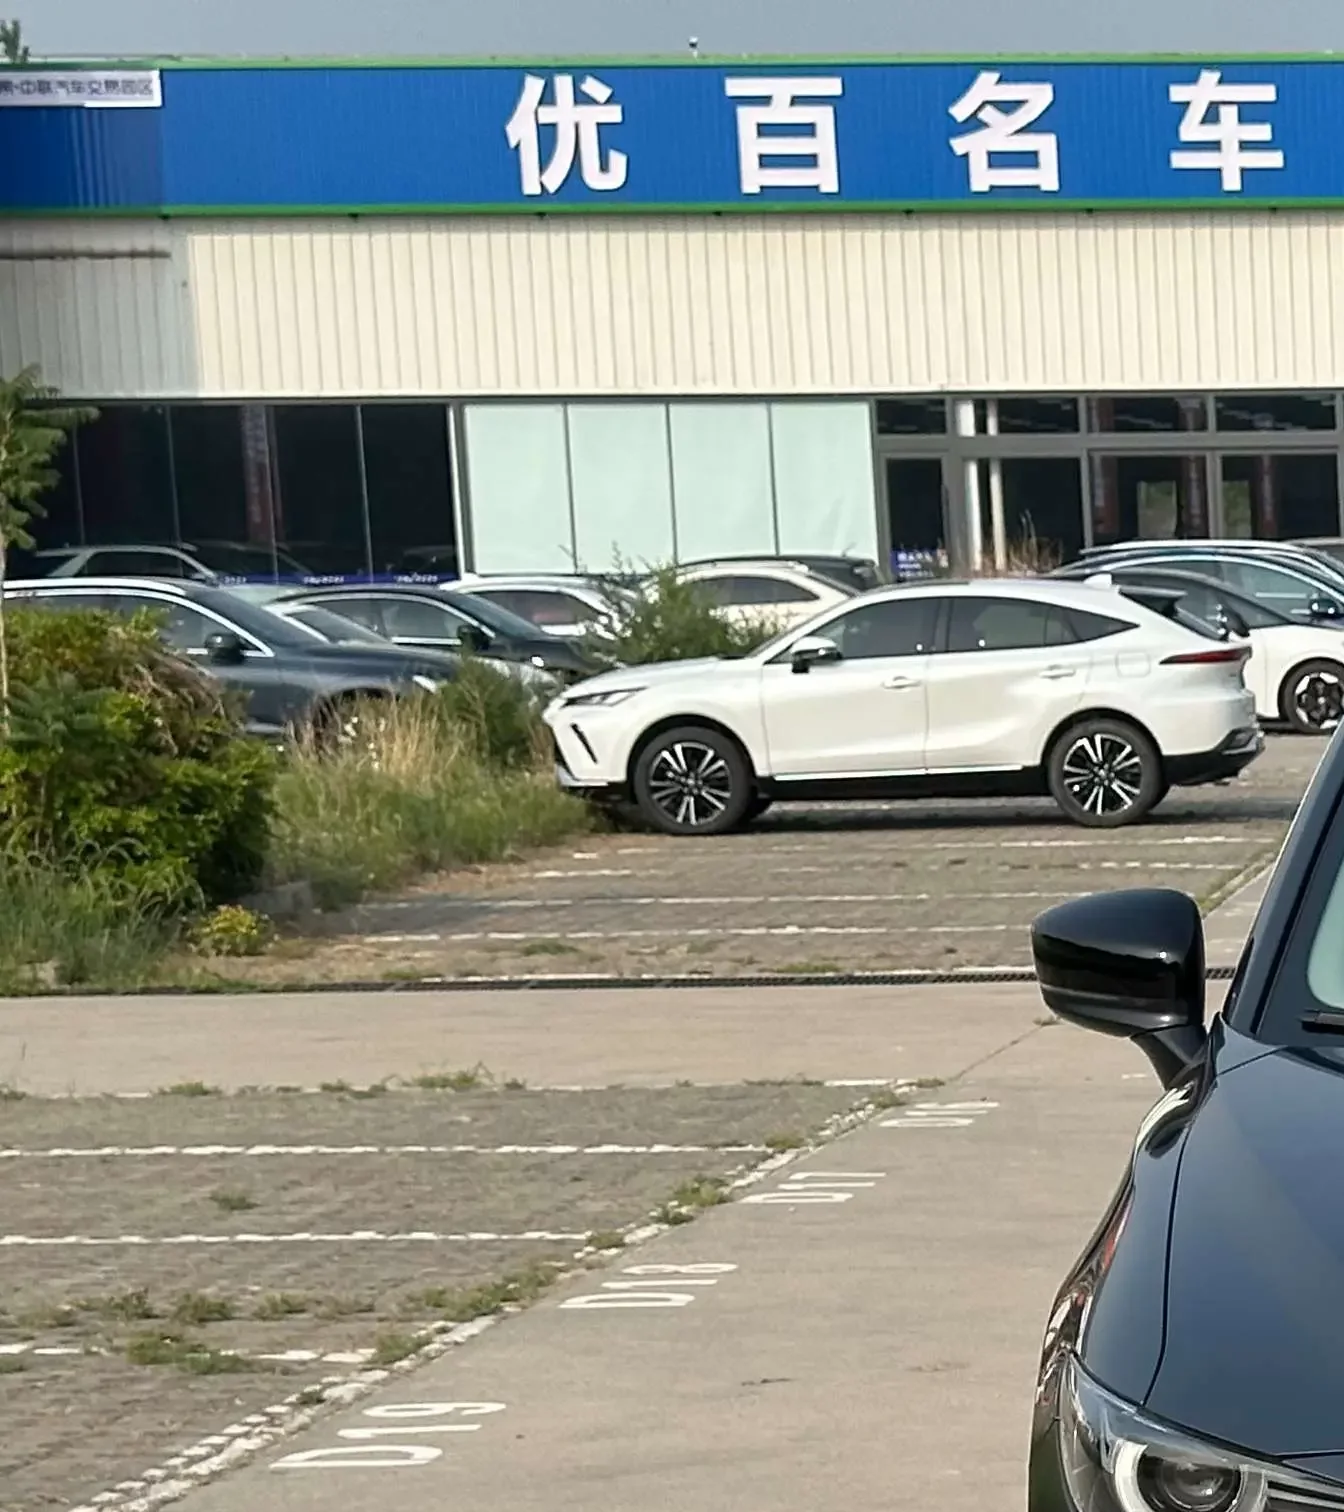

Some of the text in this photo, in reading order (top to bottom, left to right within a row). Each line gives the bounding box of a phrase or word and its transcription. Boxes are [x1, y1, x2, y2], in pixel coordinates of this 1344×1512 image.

[504, 70, 1285, 196] 优百名车
[737, 1172, 887, 1203] D17
[558, 1263, 739, 1308] D18
[269, 1402, 507, 1468] D19
